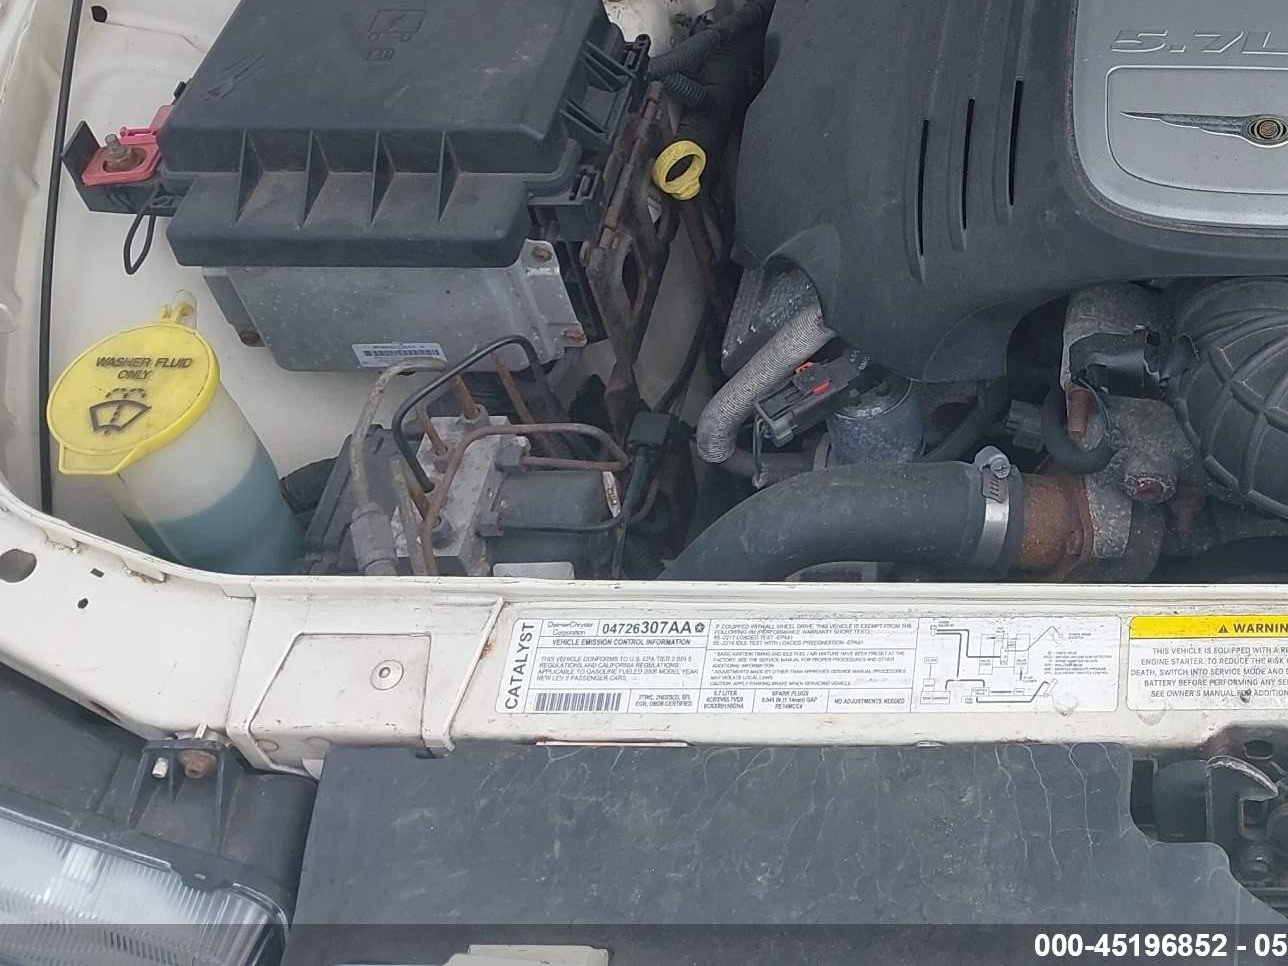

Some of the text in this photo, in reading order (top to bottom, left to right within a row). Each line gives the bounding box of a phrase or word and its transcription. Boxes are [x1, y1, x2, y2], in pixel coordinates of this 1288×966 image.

[96, 357, 194, 368] WASHER FLUID
[117, 369, 152, 380] ONLY
[602, 621, 692, 634] 04726307AA
[1252, 646, 1271, 654] WITH
[1273, 646, 1278, 654] A
[1251, 657, 1265, 665] THE
[1267, 657, 1283, 665] RISK
[504, 622, 535, 710] CATALYST
[1131, 668, 1158, 676] DEATH,
[1159, 668, 1188, 676] SWITCH
[1190, 668, 1208, 676] INTO
[1210, 668, 1240, 676] SERVICE
[1243, 668, 1265, 676] MODE
[1267, 668, 1283, 676] AND
[1178, 678, 1206, 686] BEFORE
[1209, 678, 1258, 686] PERFORMING
[1260, 678, 1275, 686] ANY
[1151, 690, 1164, 698] SEE
[1202, 689, 1233, 697] MANUAL
